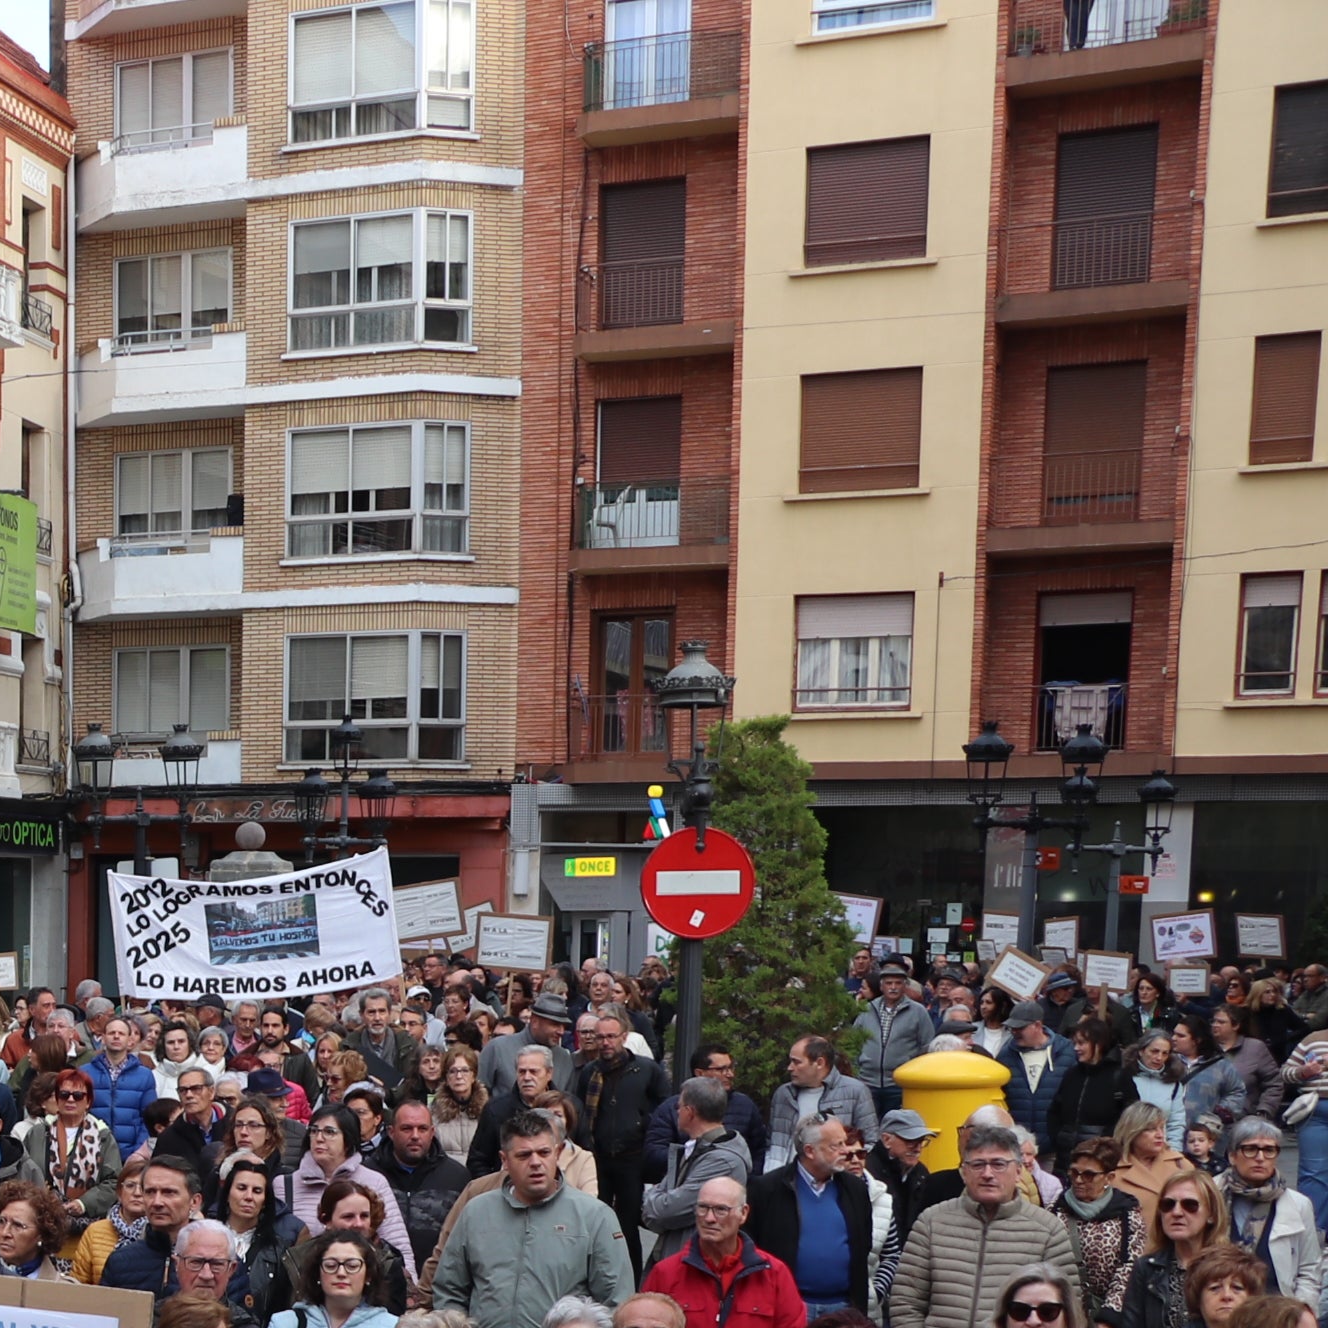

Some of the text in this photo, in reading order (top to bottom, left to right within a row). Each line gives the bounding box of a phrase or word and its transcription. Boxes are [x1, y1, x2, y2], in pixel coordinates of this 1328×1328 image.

[580, 861, 610, 872] ONCE
[120, 878, 174, 915] 2012
[126, 869, 389, 938] LO LOGRAMOS ENTONCES
[126, 921, 190, 969] 2025
[212, 936, 258, 947] SALVEMOS
[136, 960, 376, 994] LO HAREMOS AHORA
